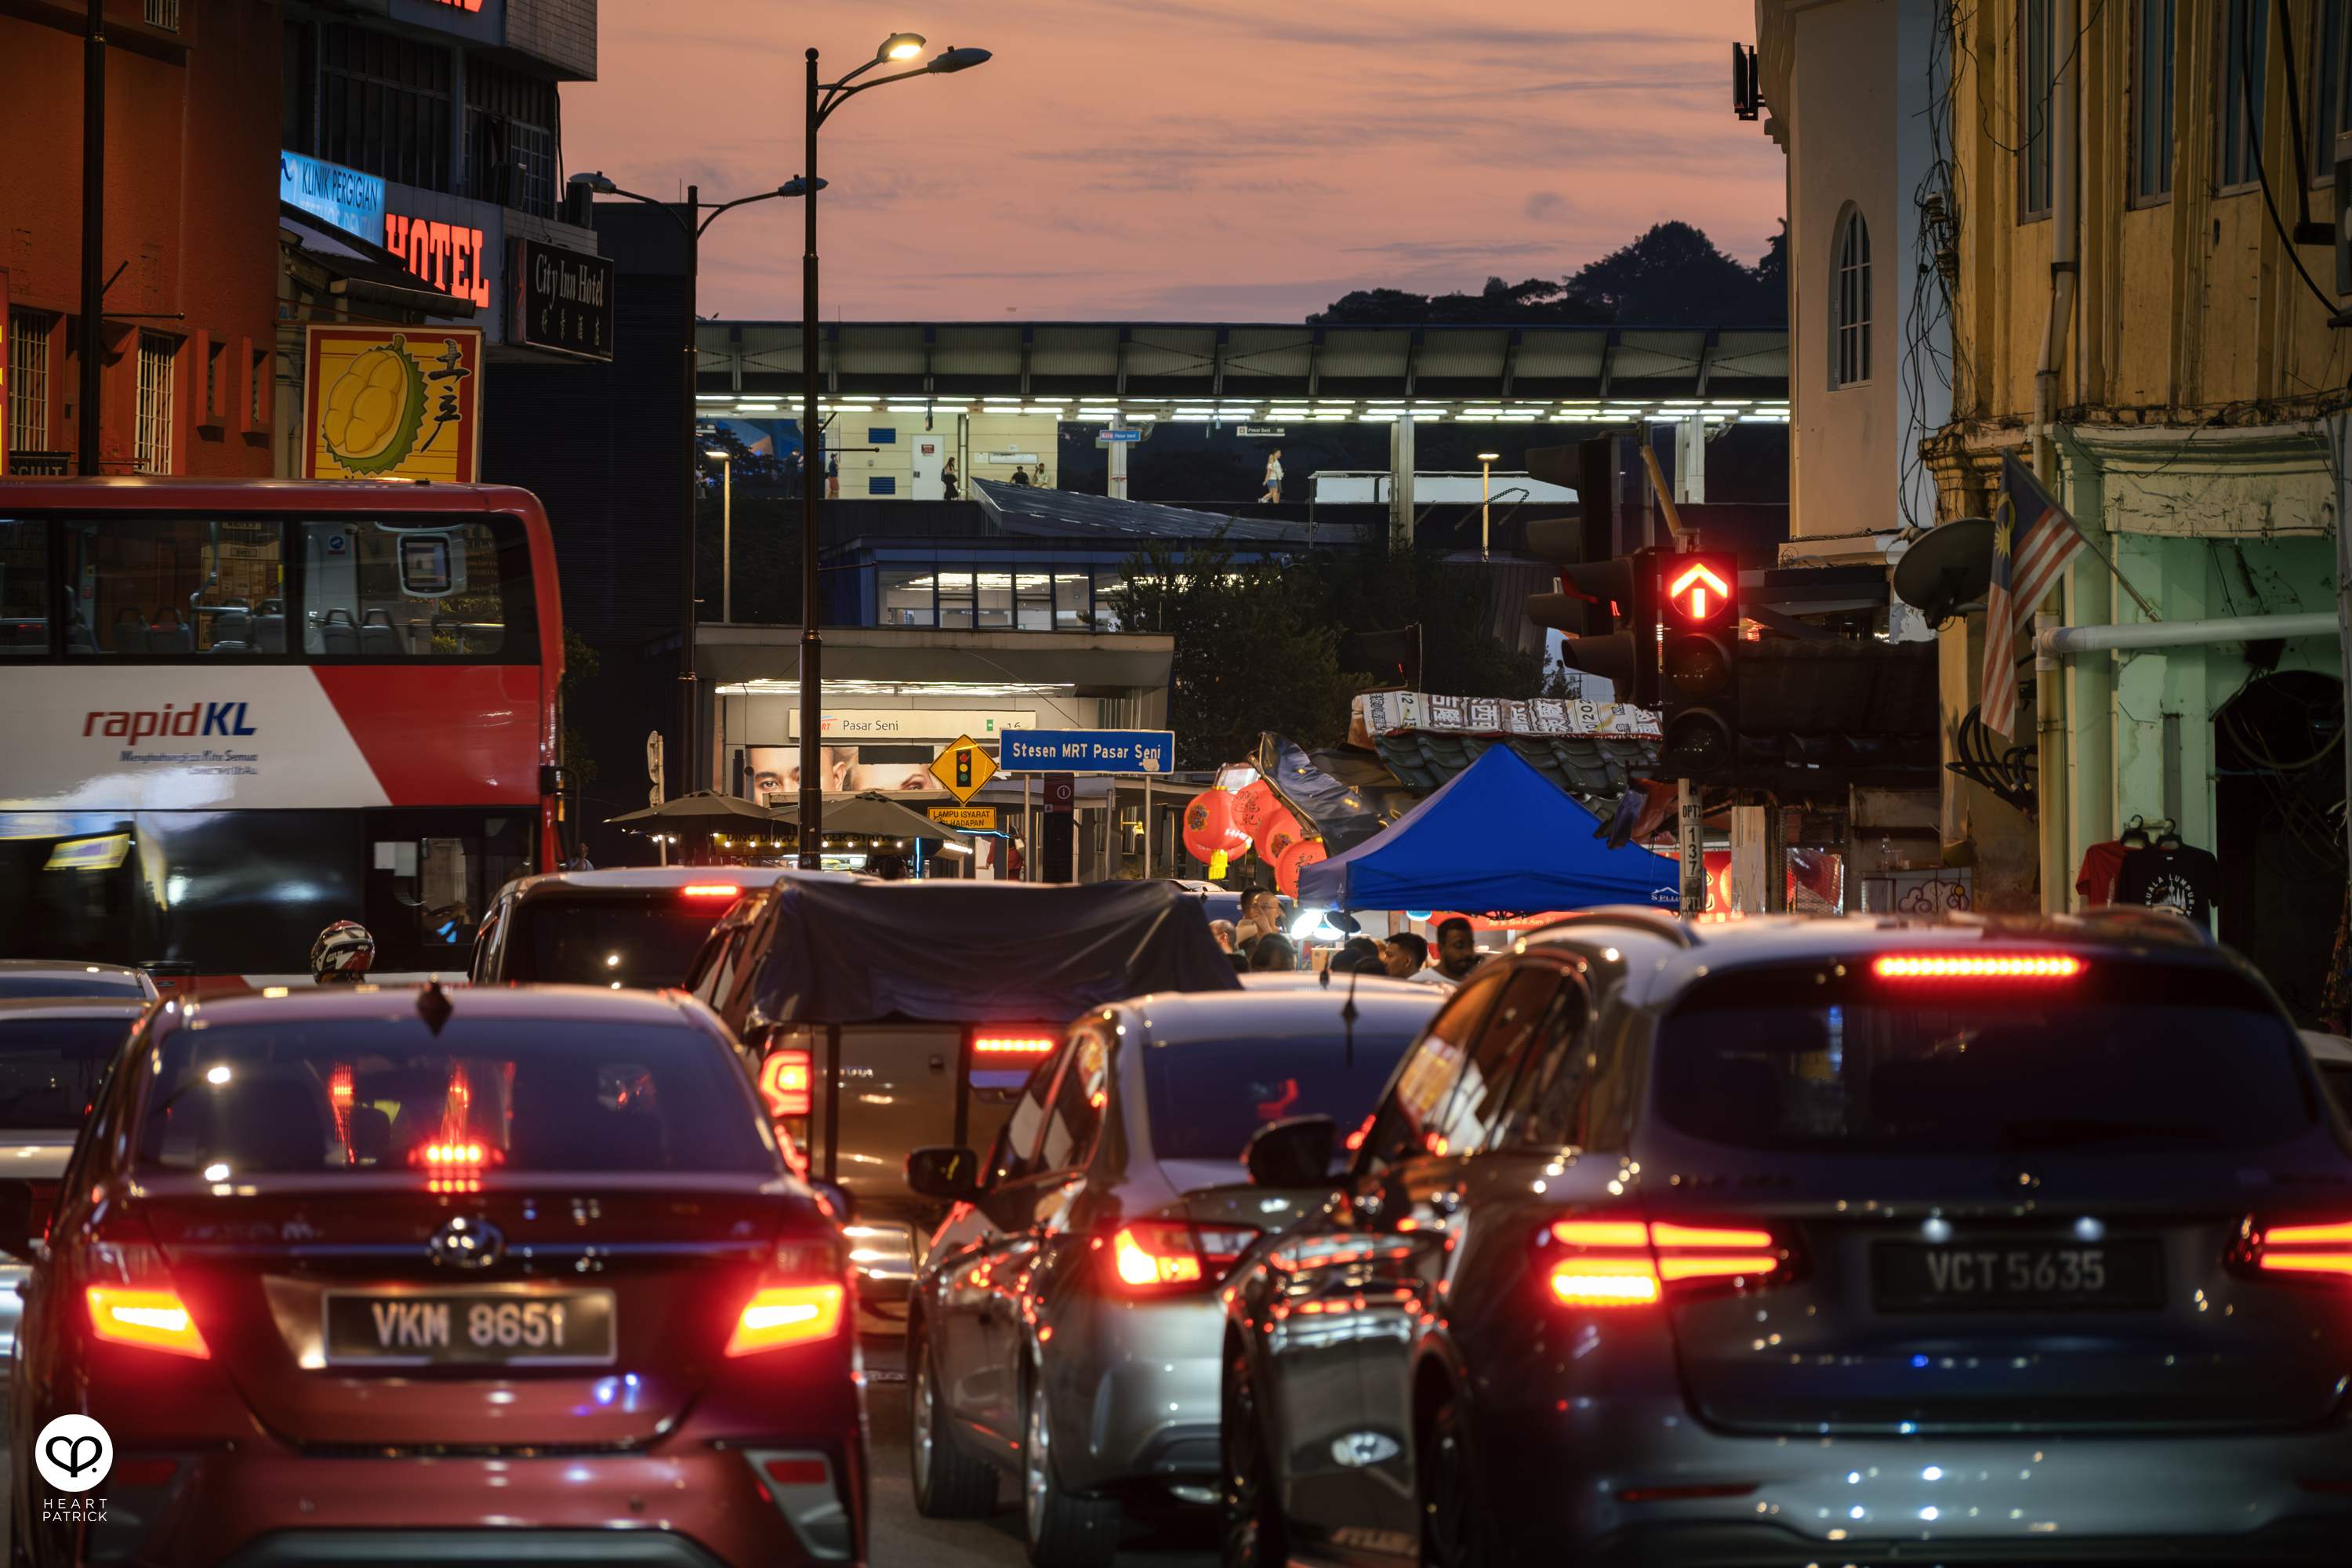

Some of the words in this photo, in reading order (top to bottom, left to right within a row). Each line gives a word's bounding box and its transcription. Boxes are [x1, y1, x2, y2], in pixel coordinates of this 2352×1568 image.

[302, 162, 330, 201] KLINIK
[332, 169, 378, 213] PERGIGIAN
[386, 213, 489, 308] HOTEL
[535, 253, 557, 310] City
[560, 259, 576, 301] Inn
[578, 264, 604, 307] Hotel
[82, 702, 259, 746] rapidKL
[843, 720, 873, 731] Pasar
[876, 720, 898, 731] Seni
[1536, 698, 1568, 732] 茨廠
[1013, 742, 1056, 757] Stesen
[1062, 743, 1088, 758] MRT
[1094, 744, 1129, 758] Pasar
[1135, 744, 1161, 759] Seni
[1682, 804, 1702, 818] OPT1
[2145, 876, 2164, 906] KUALA
[2169, 873, 2194, 905] LUMPUR
[1926, 1250, 1998, 1292] VCT
[2006, 1250, 2105, 1291] 5635
[372, 1302, 450, 1347] VKM
[468, 1302, 565, 1347] 8651
